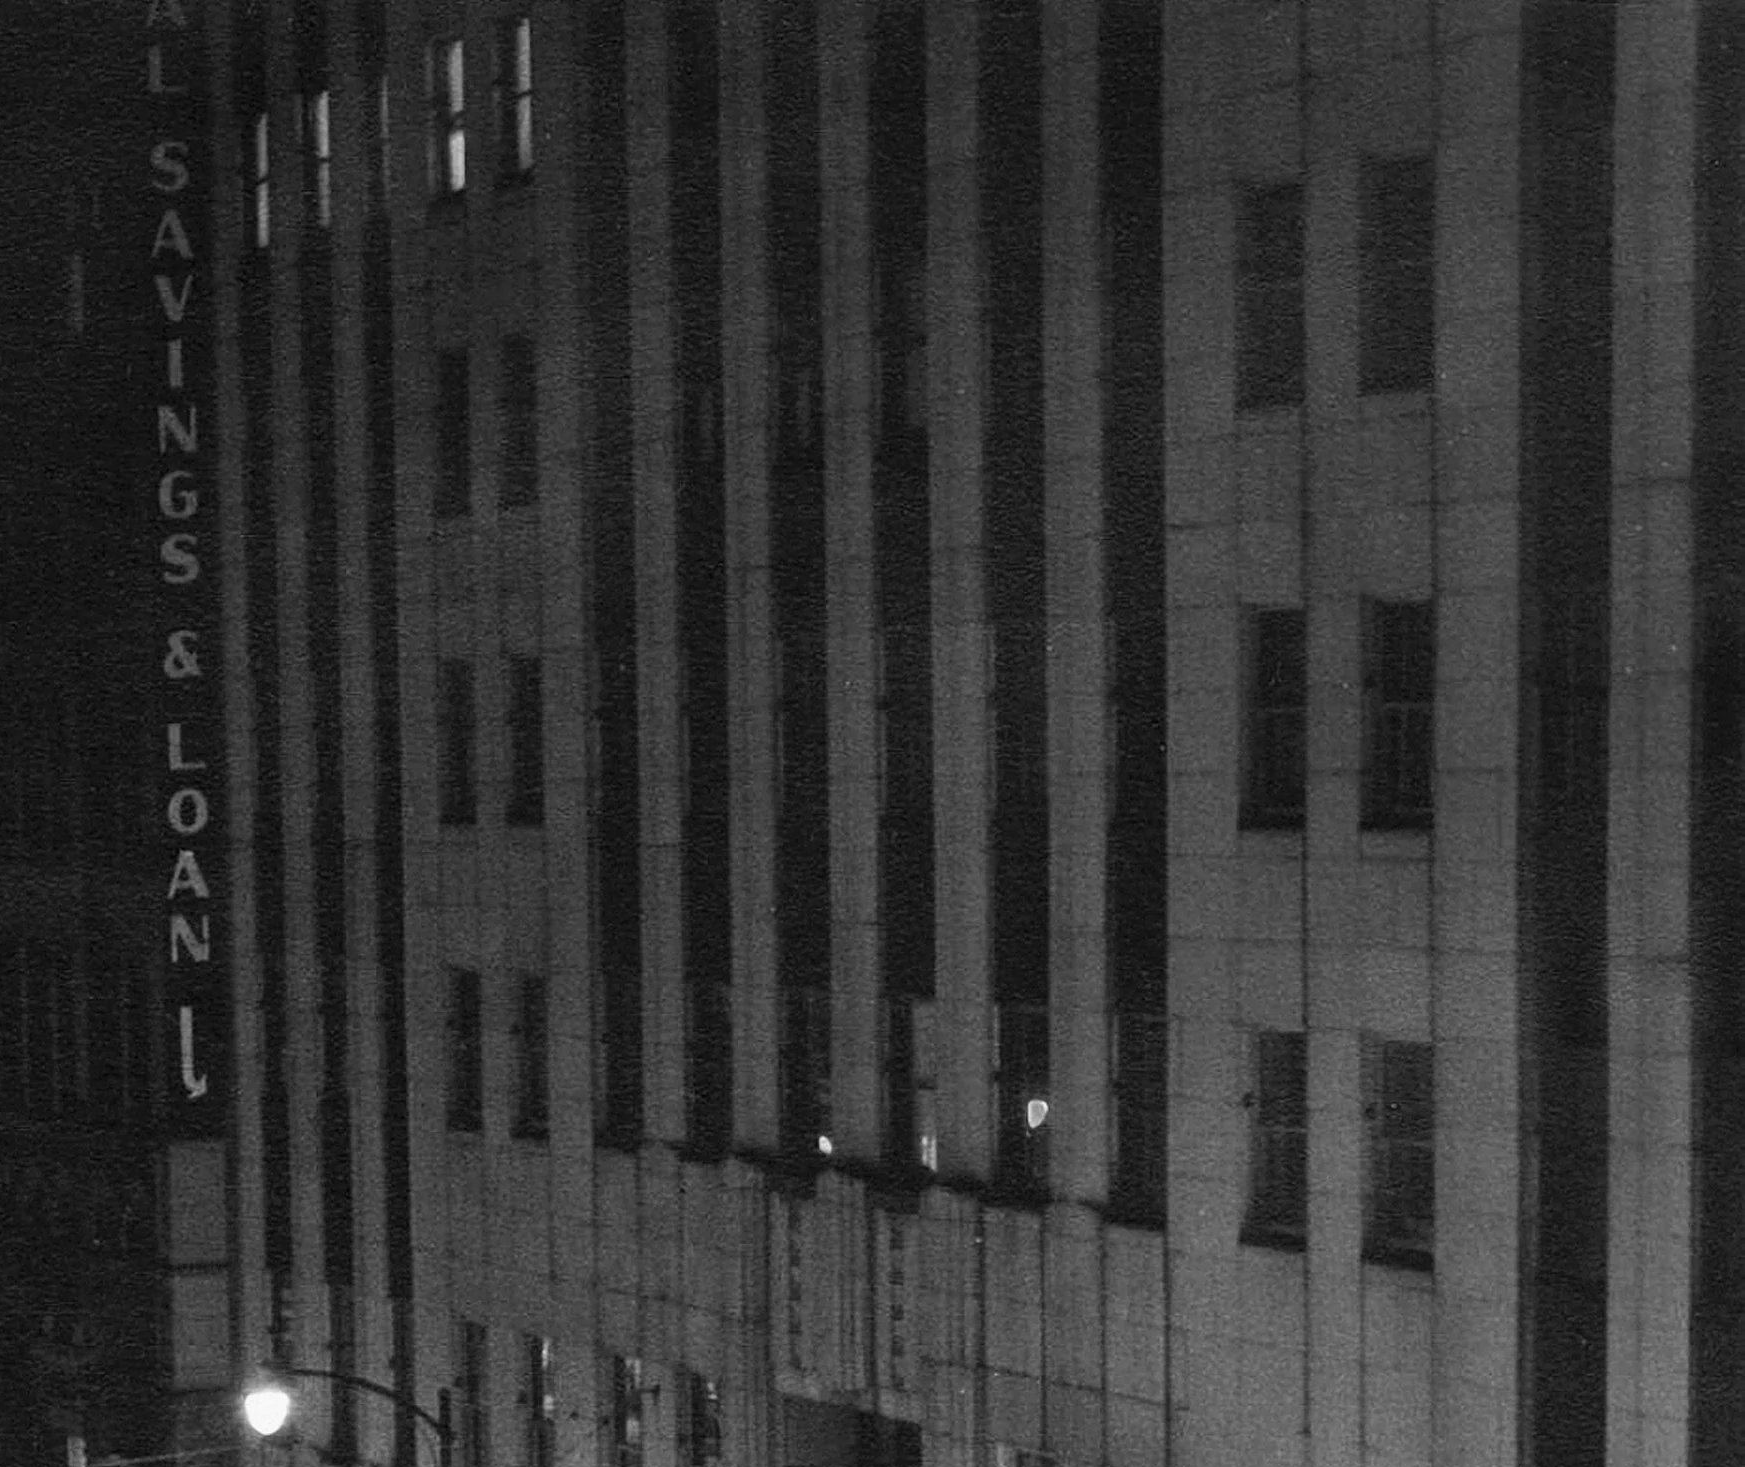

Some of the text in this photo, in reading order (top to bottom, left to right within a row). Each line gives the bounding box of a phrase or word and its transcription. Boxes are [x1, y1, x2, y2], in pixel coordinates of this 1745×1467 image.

[152, 141, 200, 585] SAVINGS
[164, 630, 202, 679] &
[167, 723, 211, 964] LOAN
